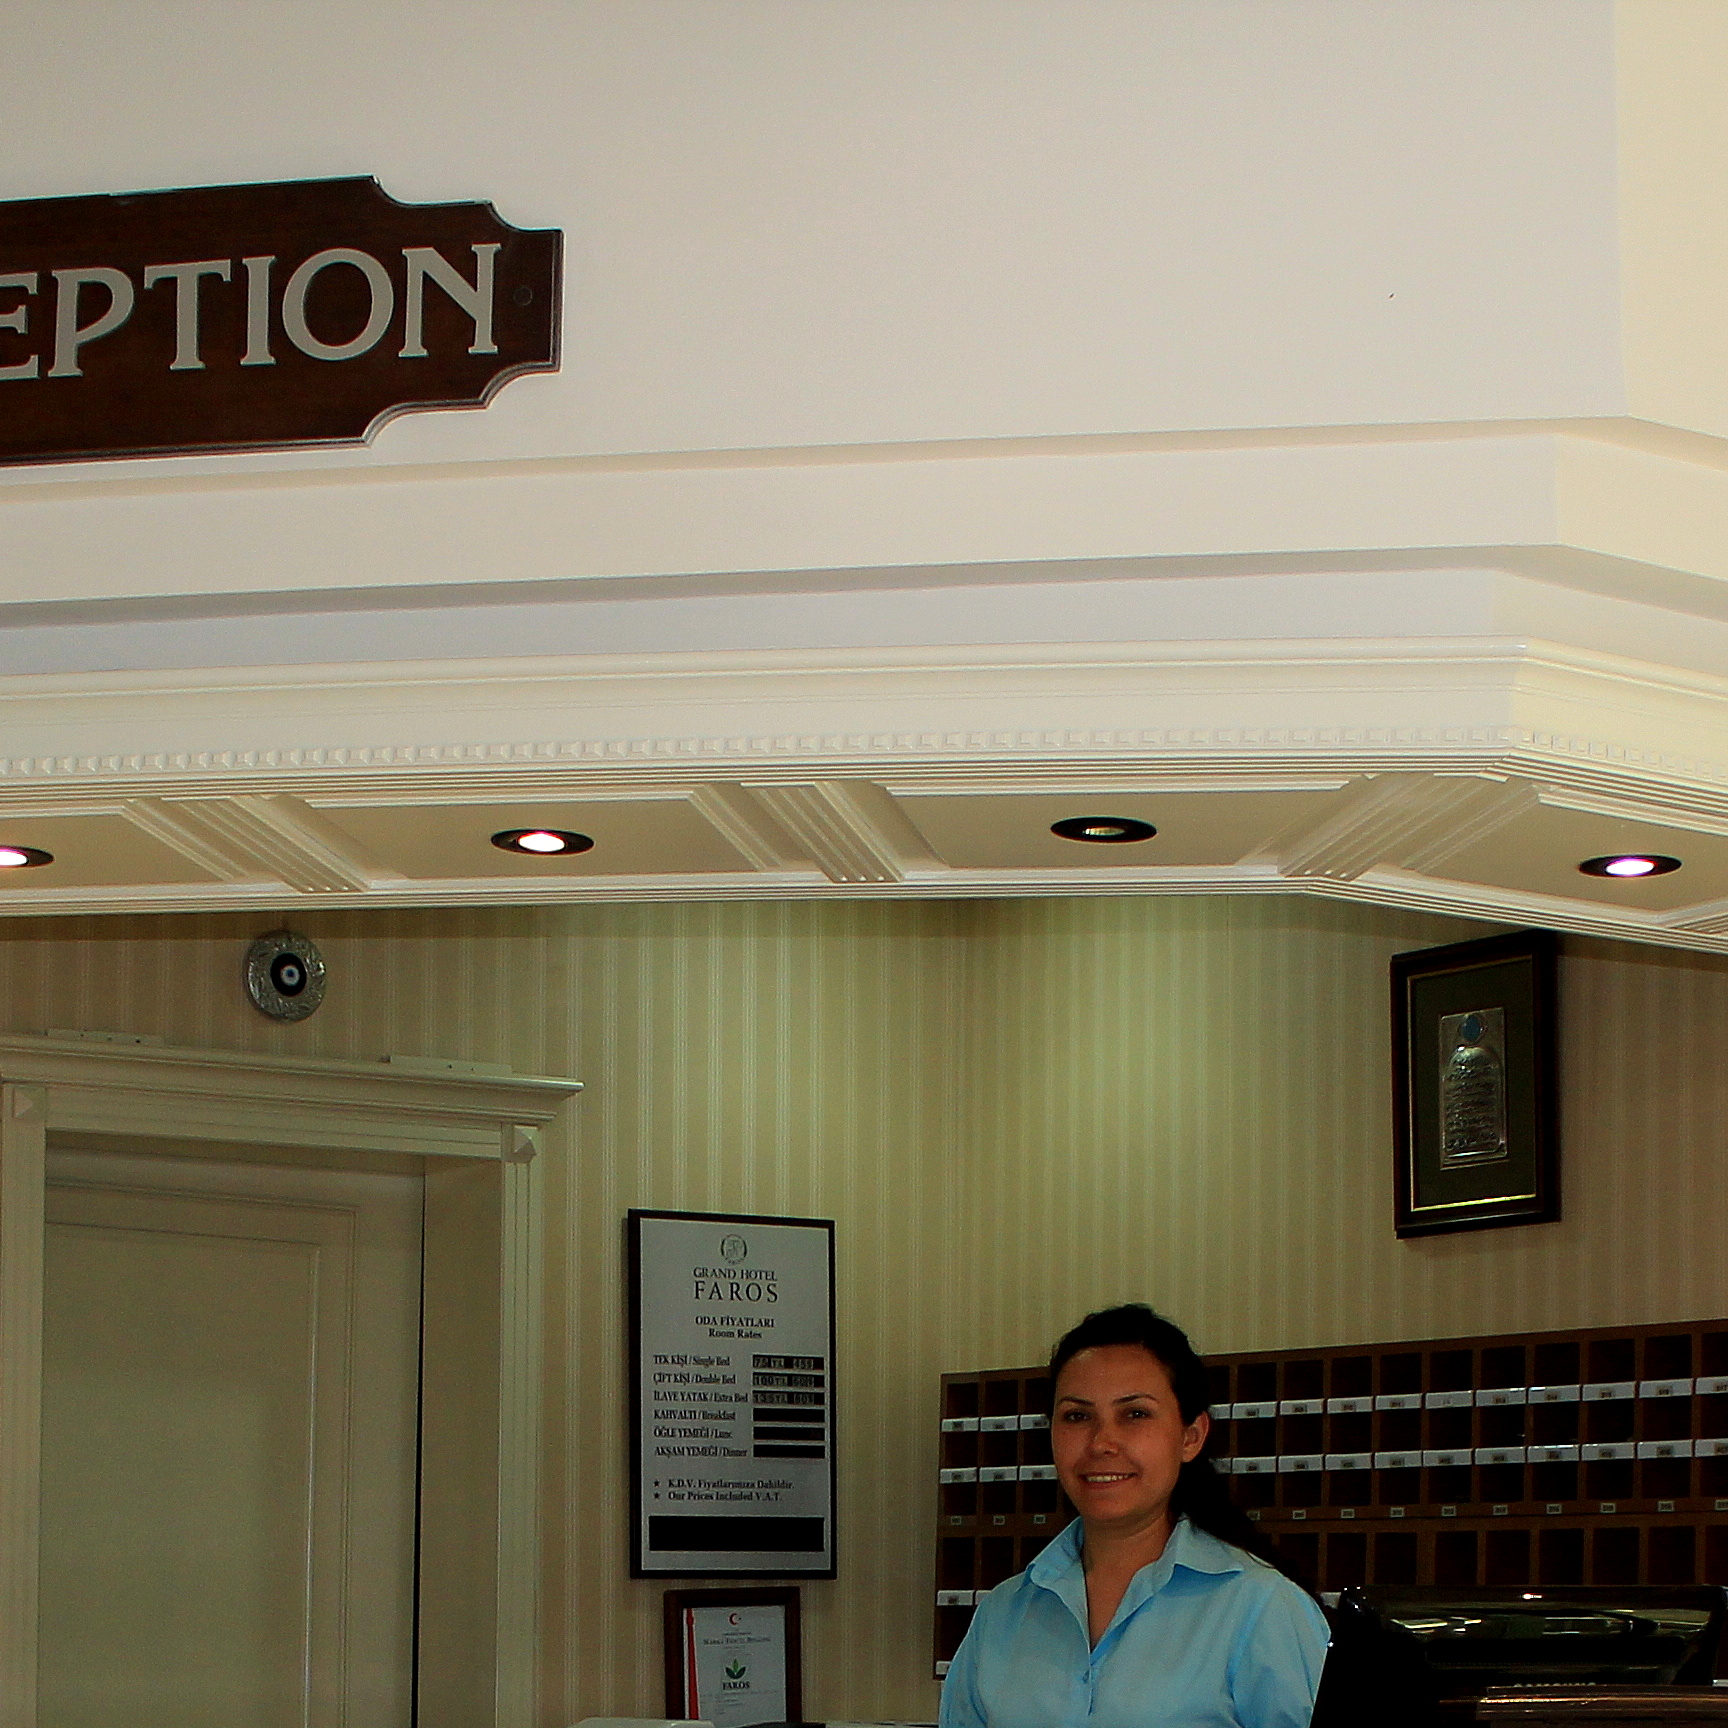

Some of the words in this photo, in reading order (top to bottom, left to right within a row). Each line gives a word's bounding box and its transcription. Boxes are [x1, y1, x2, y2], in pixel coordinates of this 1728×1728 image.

[693, 1267, 737, 1280] GRAND
[740, 1268, 778, 1281] HOTEL
[694, 1280, 779, 1303] FAROS
[695, 1315, 718, 1326] ODA
[721, 1314, 774, 1328] FİYATLARI
[708, 1328, 735, 1338] Room
[737, 1329, 762, 1339] Rates
[722, 1374, 736, 1384] Bed
[680, 1391, 710, 1402] YATAK
[735, 1393, 749, 1402] Bed
[722, 1681, 750, 1690] FAROS
